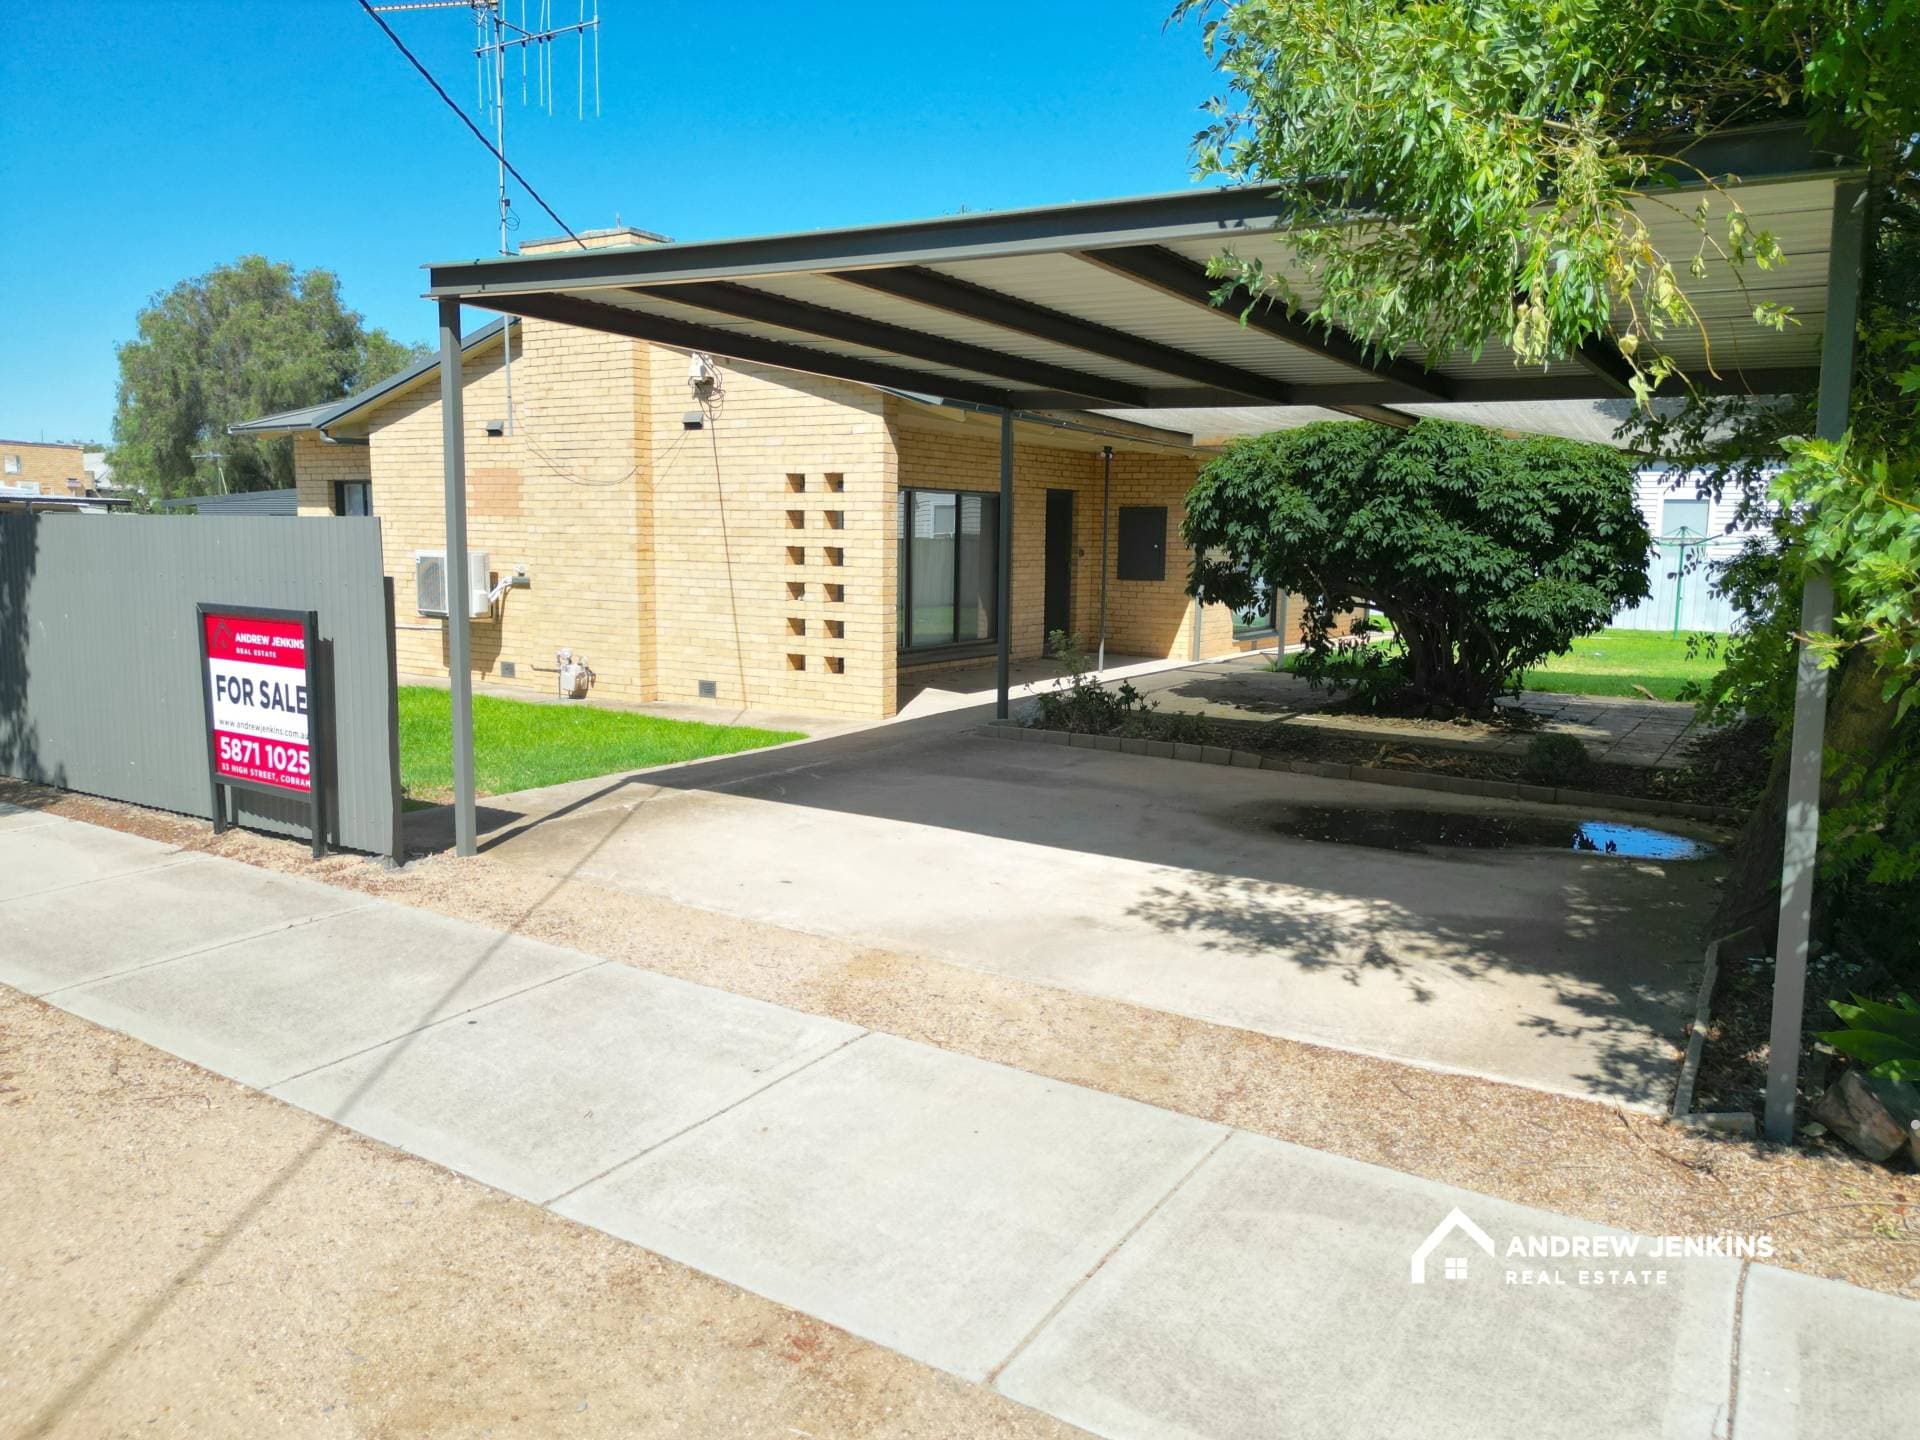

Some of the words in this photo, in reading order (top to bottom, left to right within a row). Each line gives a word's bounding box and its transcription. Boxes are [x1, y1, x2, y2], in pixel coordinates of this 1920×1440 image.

[235, 633, 270, 645] ANDREW
[272, 636, 305, 649] JENKINS
[236, 648, 251, 656] REAL
[254, 649, 277, 658] ESTATE
[215, 675, 255, 708] FOR
[259, 680, 307, 714] SALE
[220, 736, 260, 766] 5871
[265, 744, 310, 775] 1025
[232, 764, 248, 775] HIGH
[250, 768, 279, 782] STREET,
[280, 774, 311, 788] COBRAM
